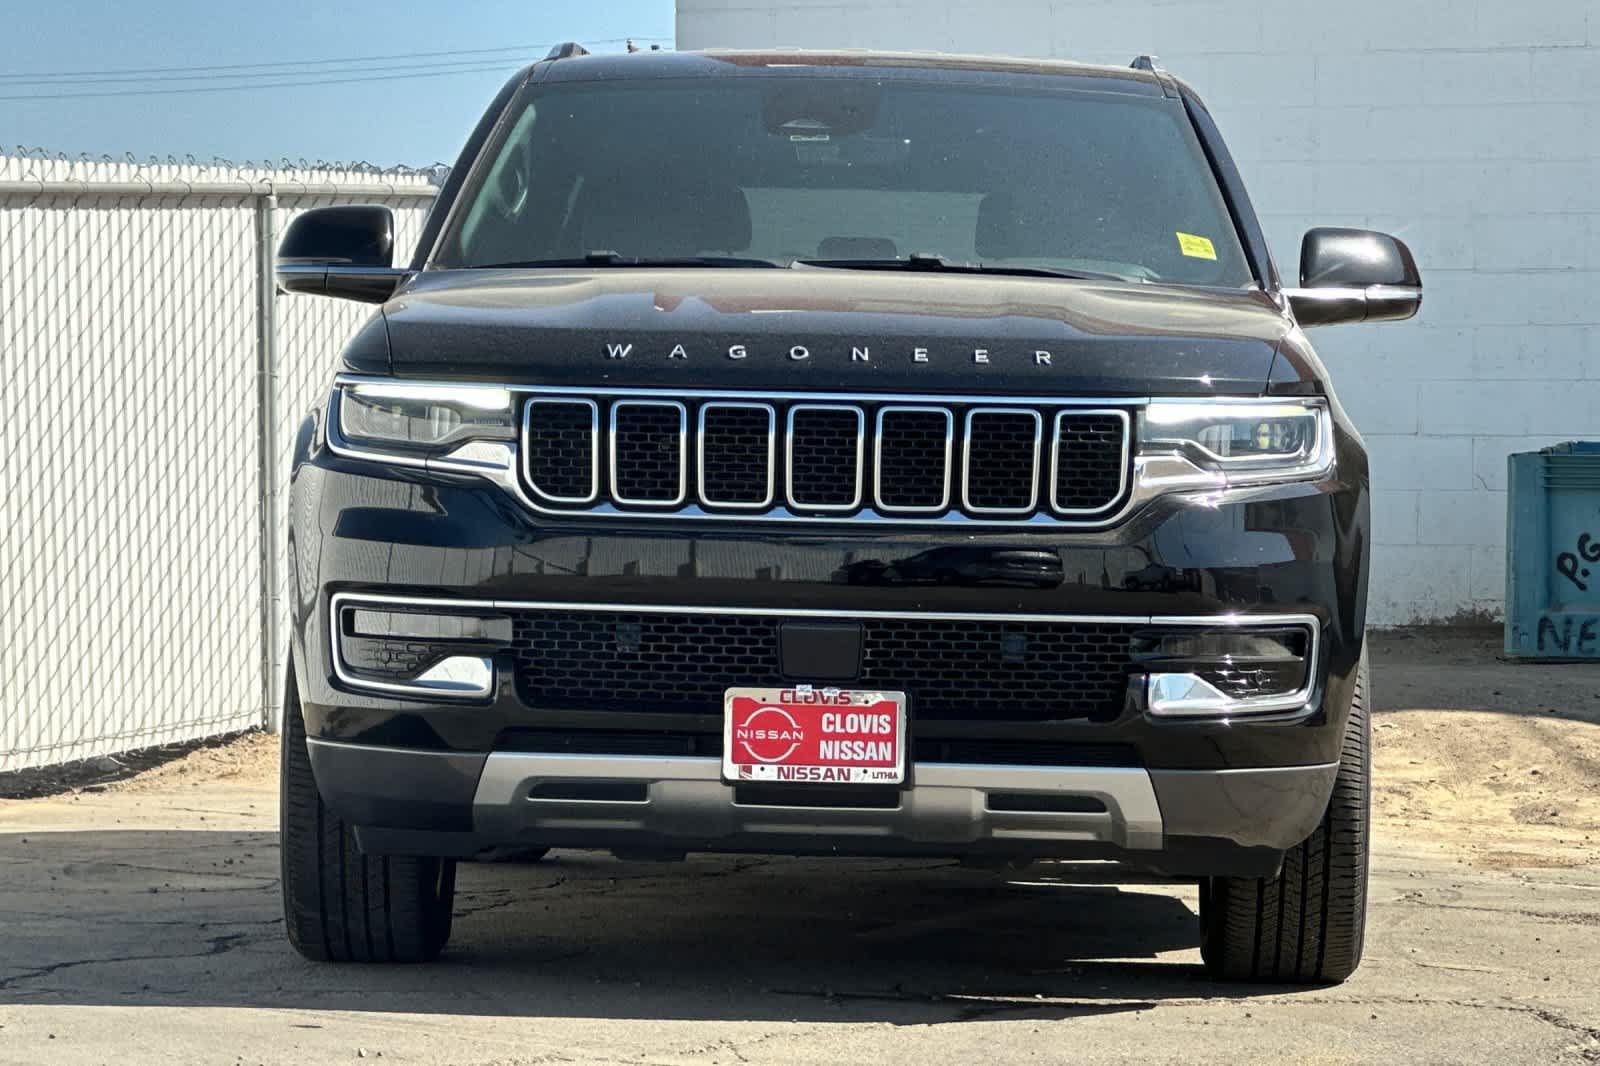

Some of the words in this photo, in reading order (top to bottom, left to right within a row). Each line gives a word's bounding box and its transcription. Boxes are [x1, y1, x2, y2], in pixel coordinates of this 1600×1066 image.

[607, 342, 1052, 365] WAGONEER
[736, 728, 804, 740] NISSAN
[821, 713, 892, 734] CLOVIS
[819, 740, 892, 761] NISSAN
[777, 766, 851, 781] NISSAN
